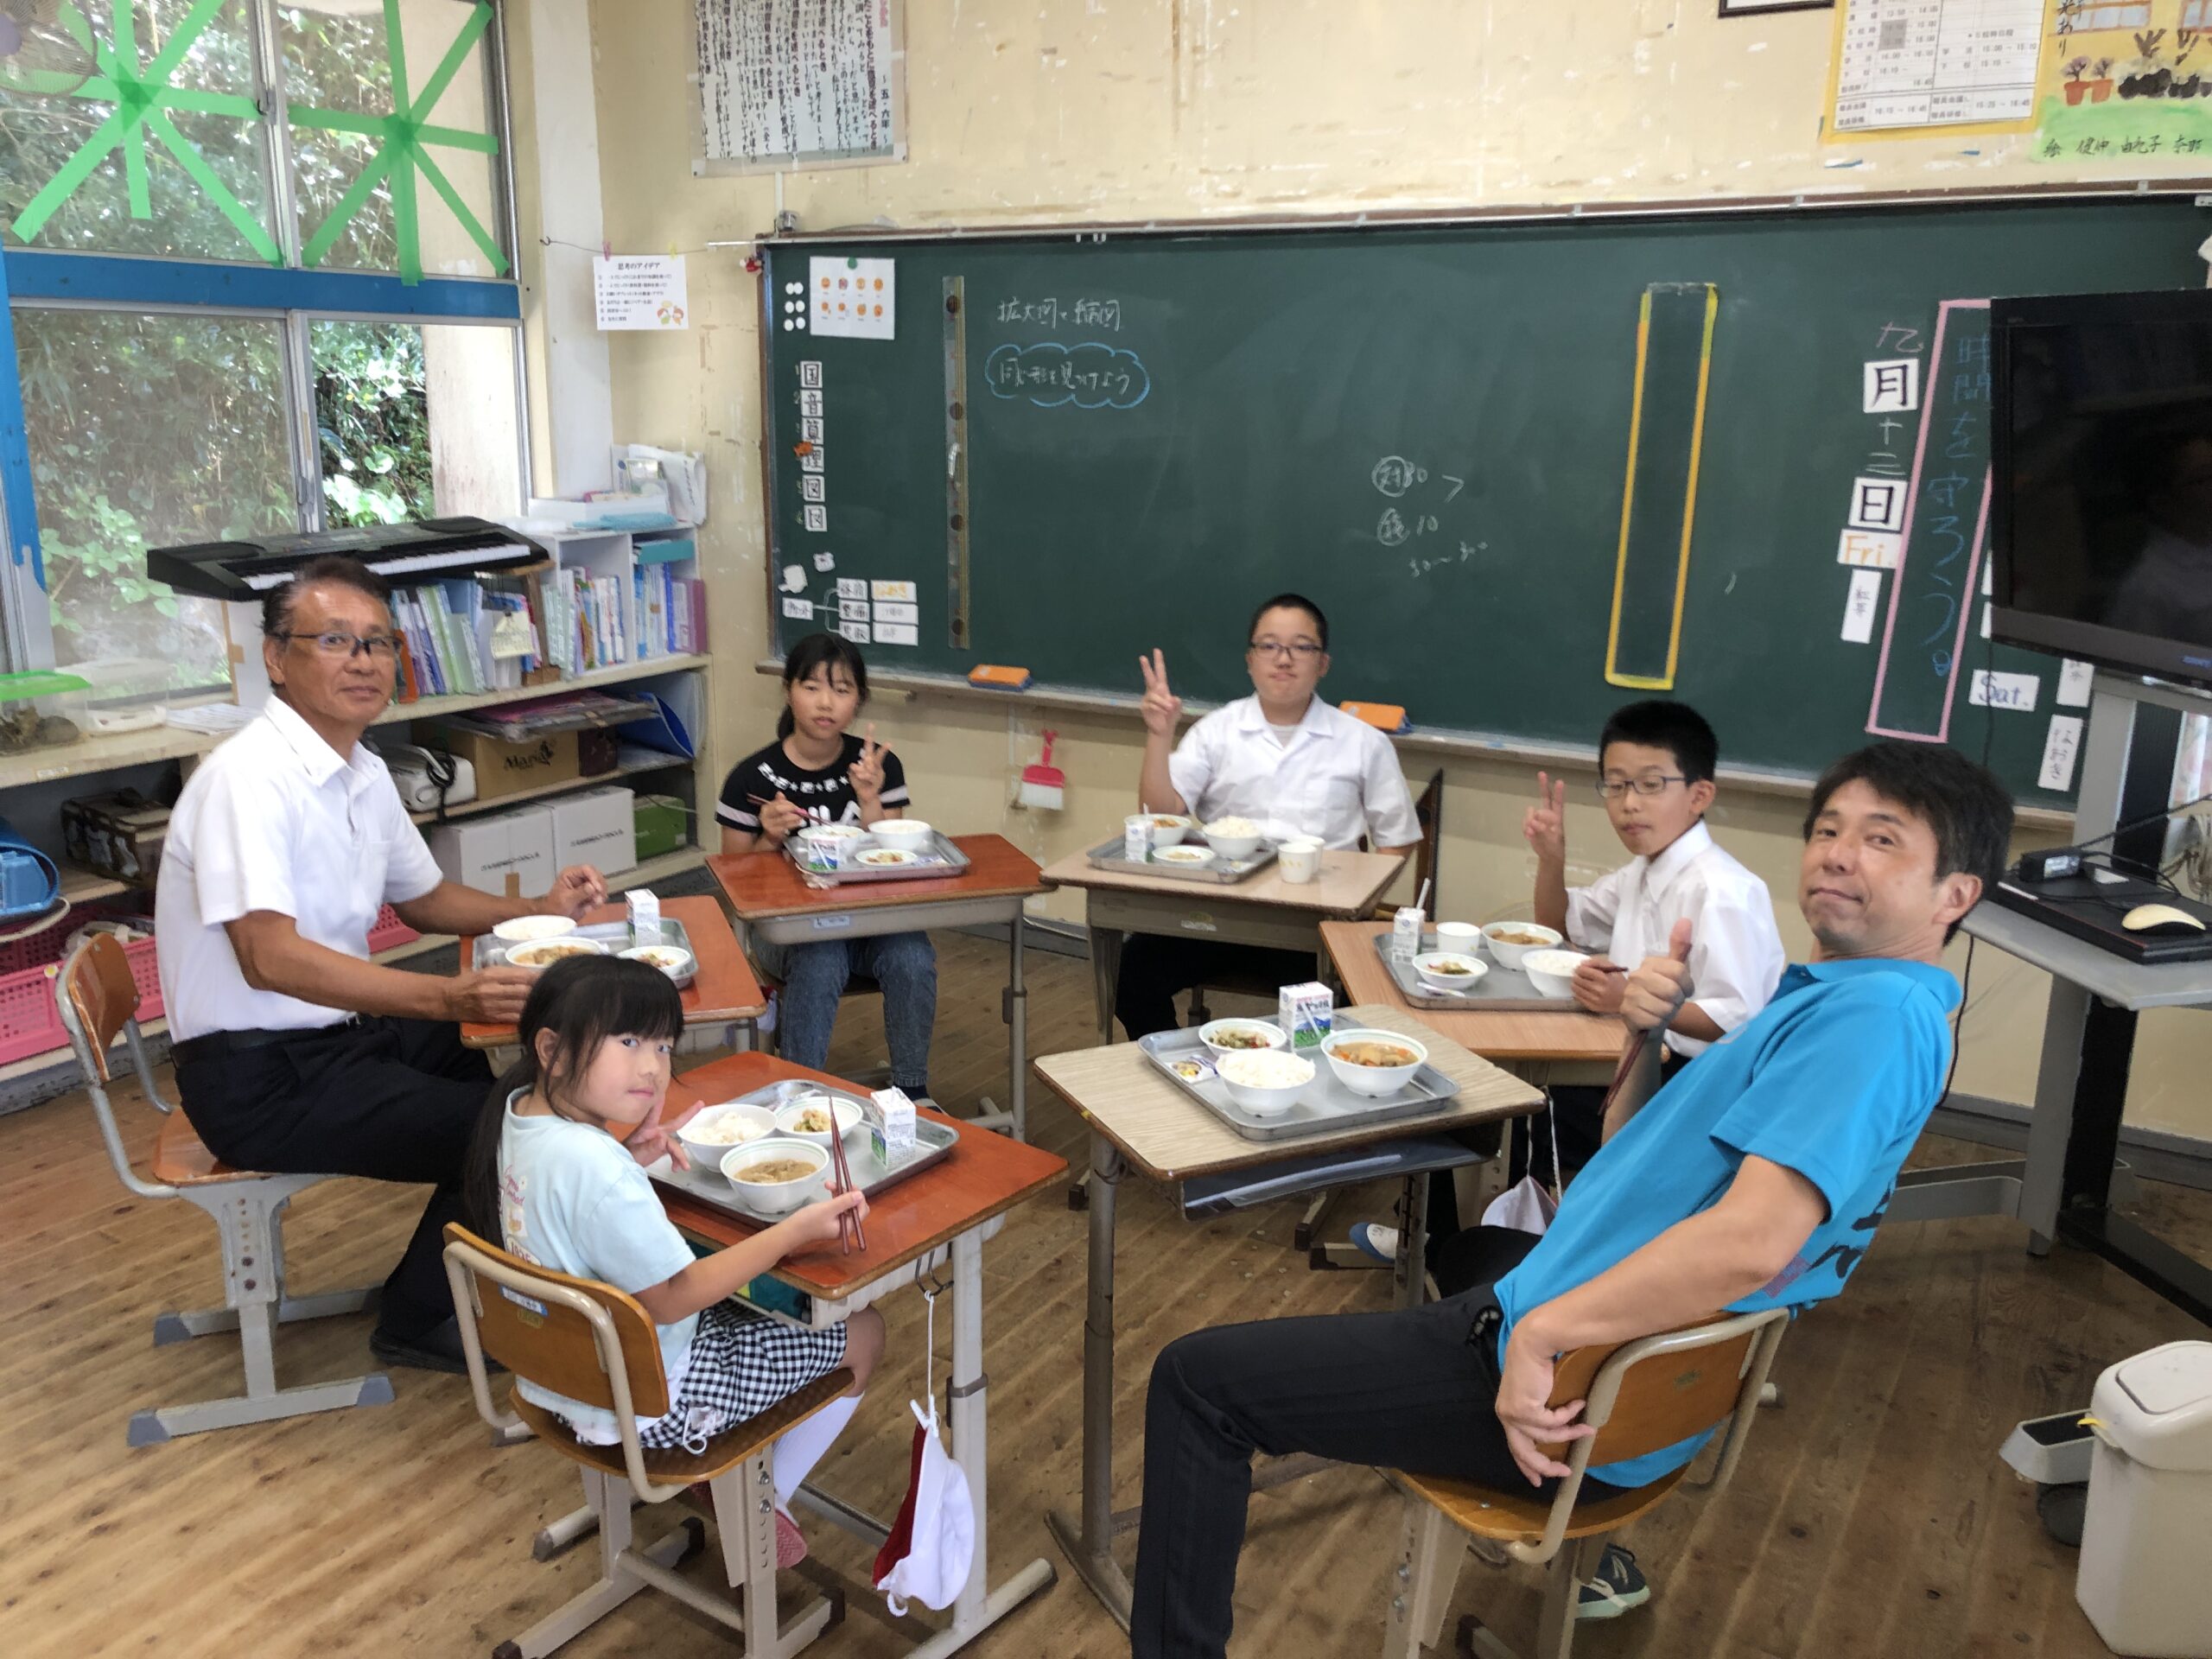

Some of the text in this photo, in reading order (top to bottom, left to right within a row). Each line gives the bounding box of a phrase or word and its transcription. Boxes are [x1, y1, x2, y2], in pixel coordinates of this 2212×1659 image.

[804, 391, 823, 415] 音
[1844, 534, 1894, 567] Fri.
[1979, 673, 2030, 709] Sat.
